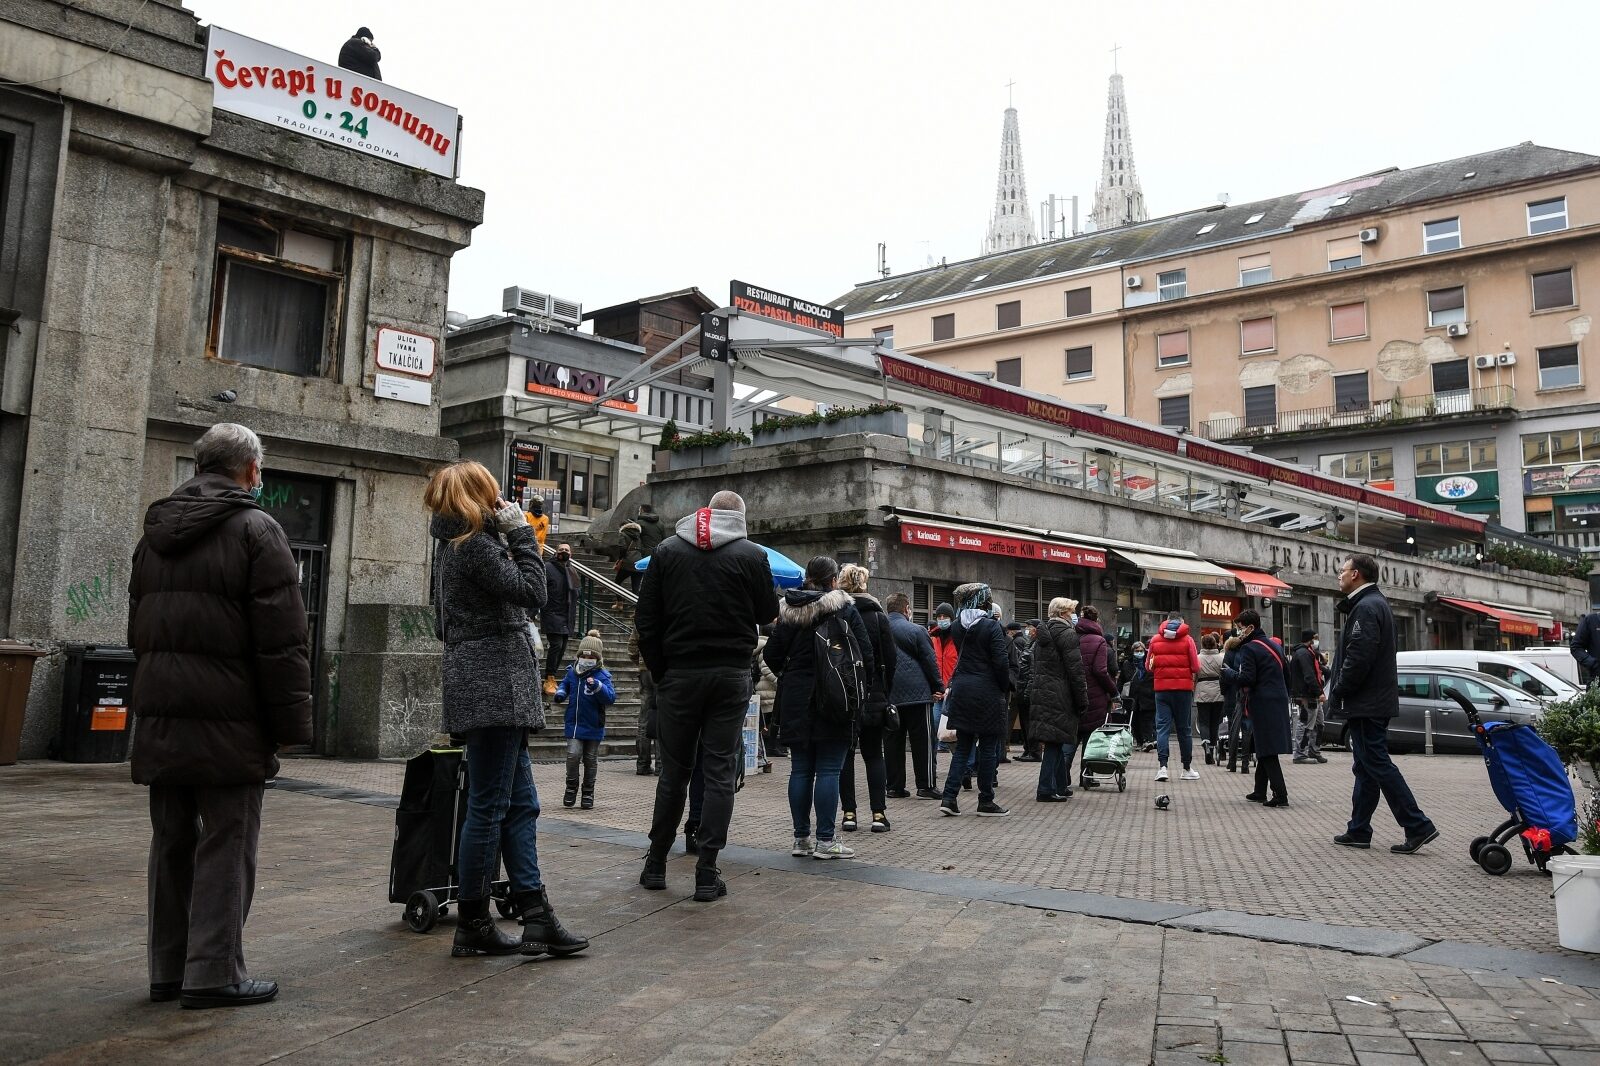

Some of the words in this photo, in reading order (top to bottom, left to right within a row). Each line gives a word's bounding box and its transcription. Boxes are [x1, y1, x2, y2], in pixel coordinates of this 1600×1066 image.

[214, 50, 314, 96] Čevapi
[325, 77, 343, 99] u
[350, 86, 451, 156] somunu
[302, 99, 317, 119] 0
[339, 110, 370, 139] 24
[276, 115, 336, 139] TRADICIJA
[340, 135, 353, 144] 40
[357, 140, 400, 159] GODINA
[746, 286, 791, 308] RESTAURANT
[397, 335, 417, 345] ULICA
[397, 343, 416, 353] IVANA
[389, 352, 423, 371] TKALČIĆA
[540, 386, 566, 397] MJESTO
[929, 374, 957, 393] DRVENI
[988, 541, 1006, 553] caffe
[1006, 544, 1017, 554] bar
[1020, 543, 1035, 557] KIM
[1269, 545, 1341, 575] TRŽNIC
[1202, 599, 1232, 617] TISAK
